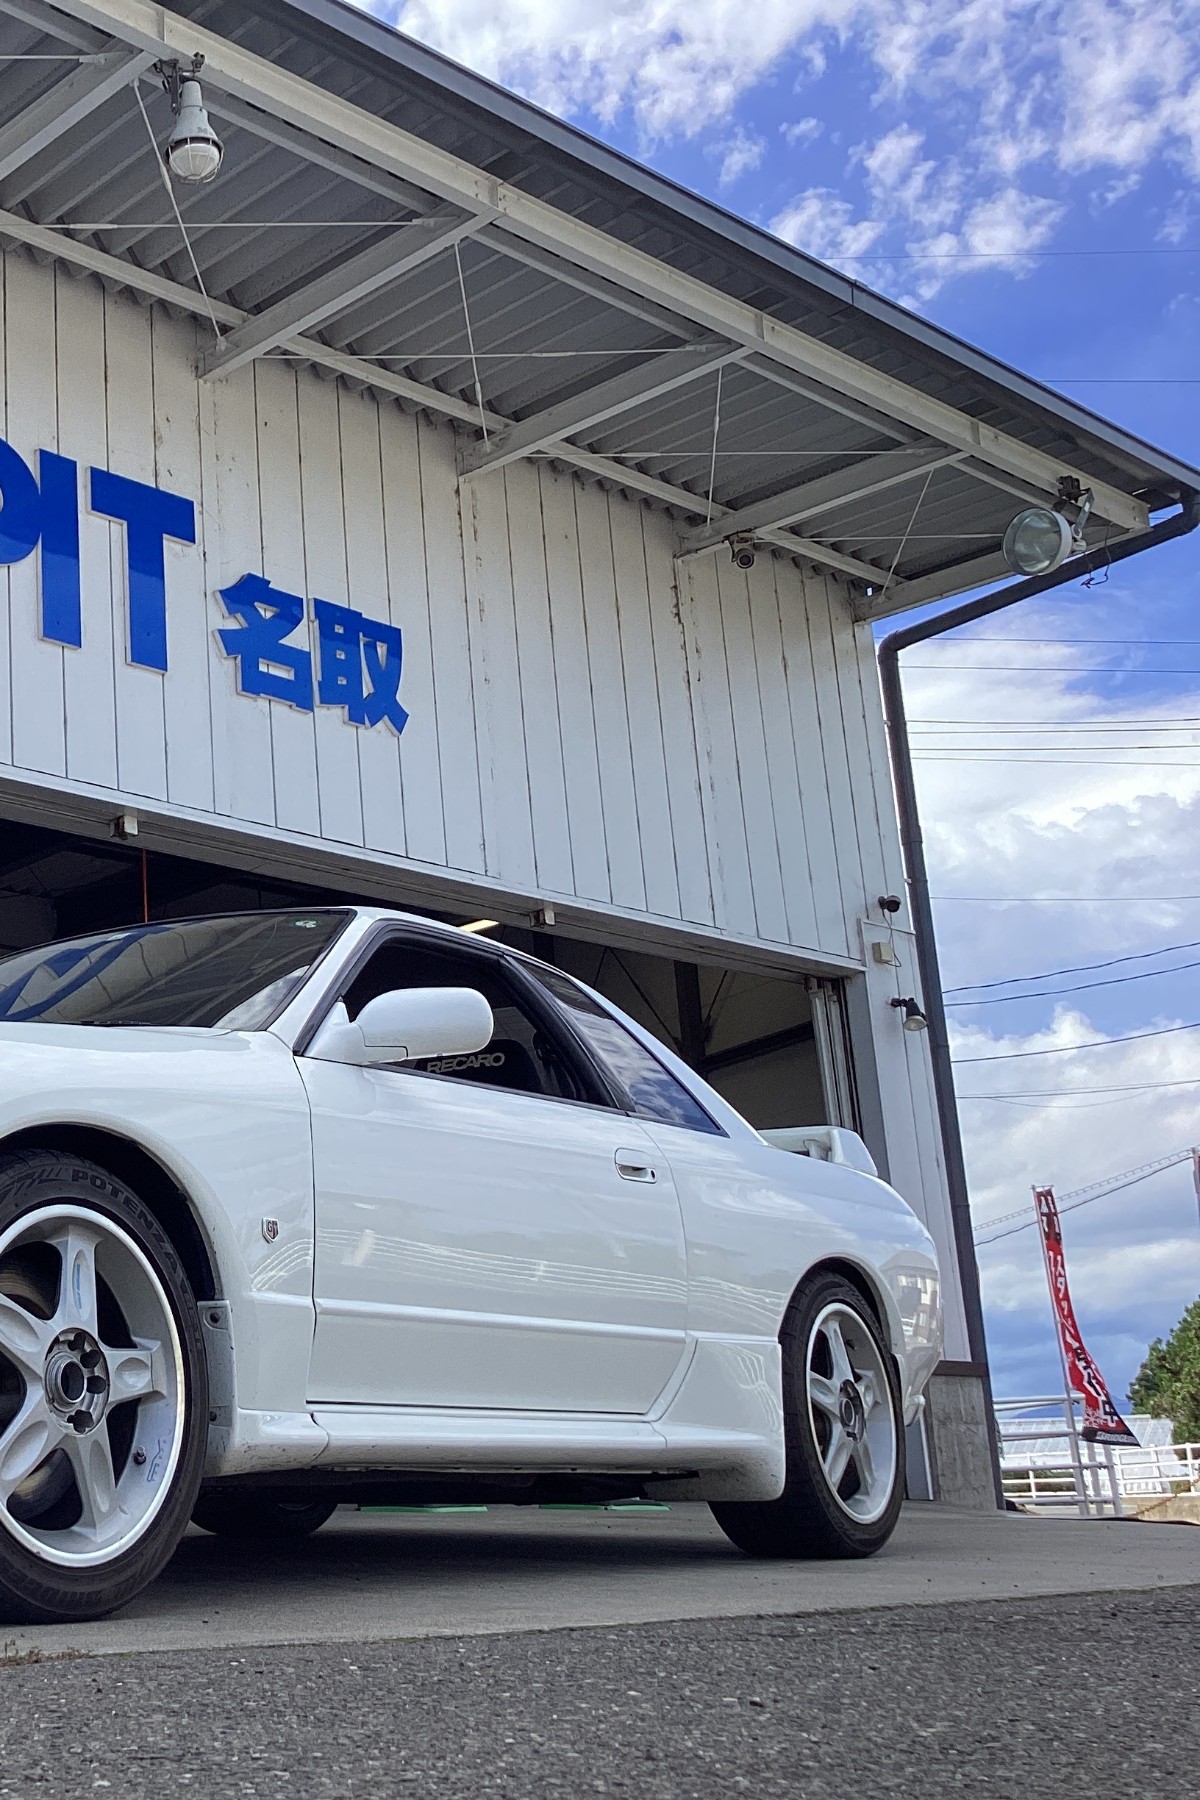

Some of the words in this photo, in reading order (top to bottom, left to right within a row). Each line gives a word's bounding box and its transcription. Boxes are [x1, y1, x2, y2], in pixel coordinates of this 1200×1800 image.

[213, 572, 410, 736] 名取
[426, 1052, 505, 1074] RECARO
[71, 1168, 181, 1276] POTENZA
